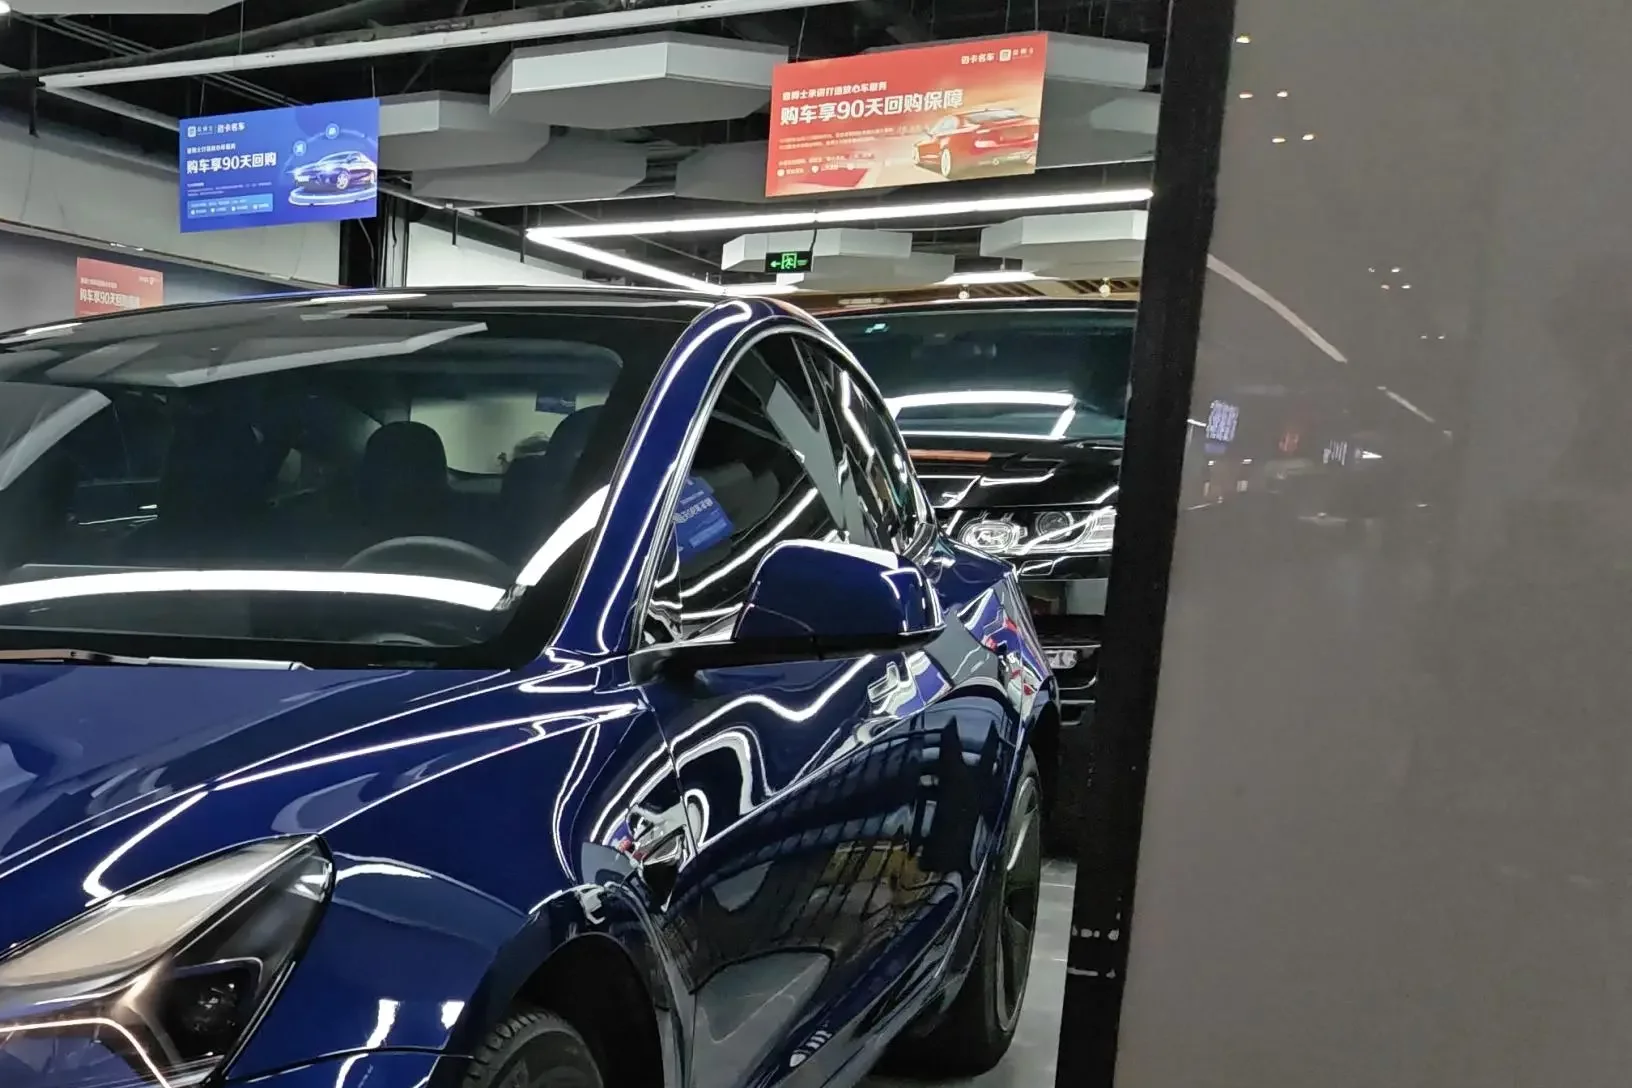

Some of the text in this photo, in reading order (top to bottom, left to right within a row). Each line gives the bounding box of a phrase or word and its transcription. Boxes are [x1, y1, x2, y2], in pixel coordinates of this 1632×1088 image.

[779, 88, 965, 126] 购车享90天回购保障
[186, 152, 277, 174] 购车享90天回购
